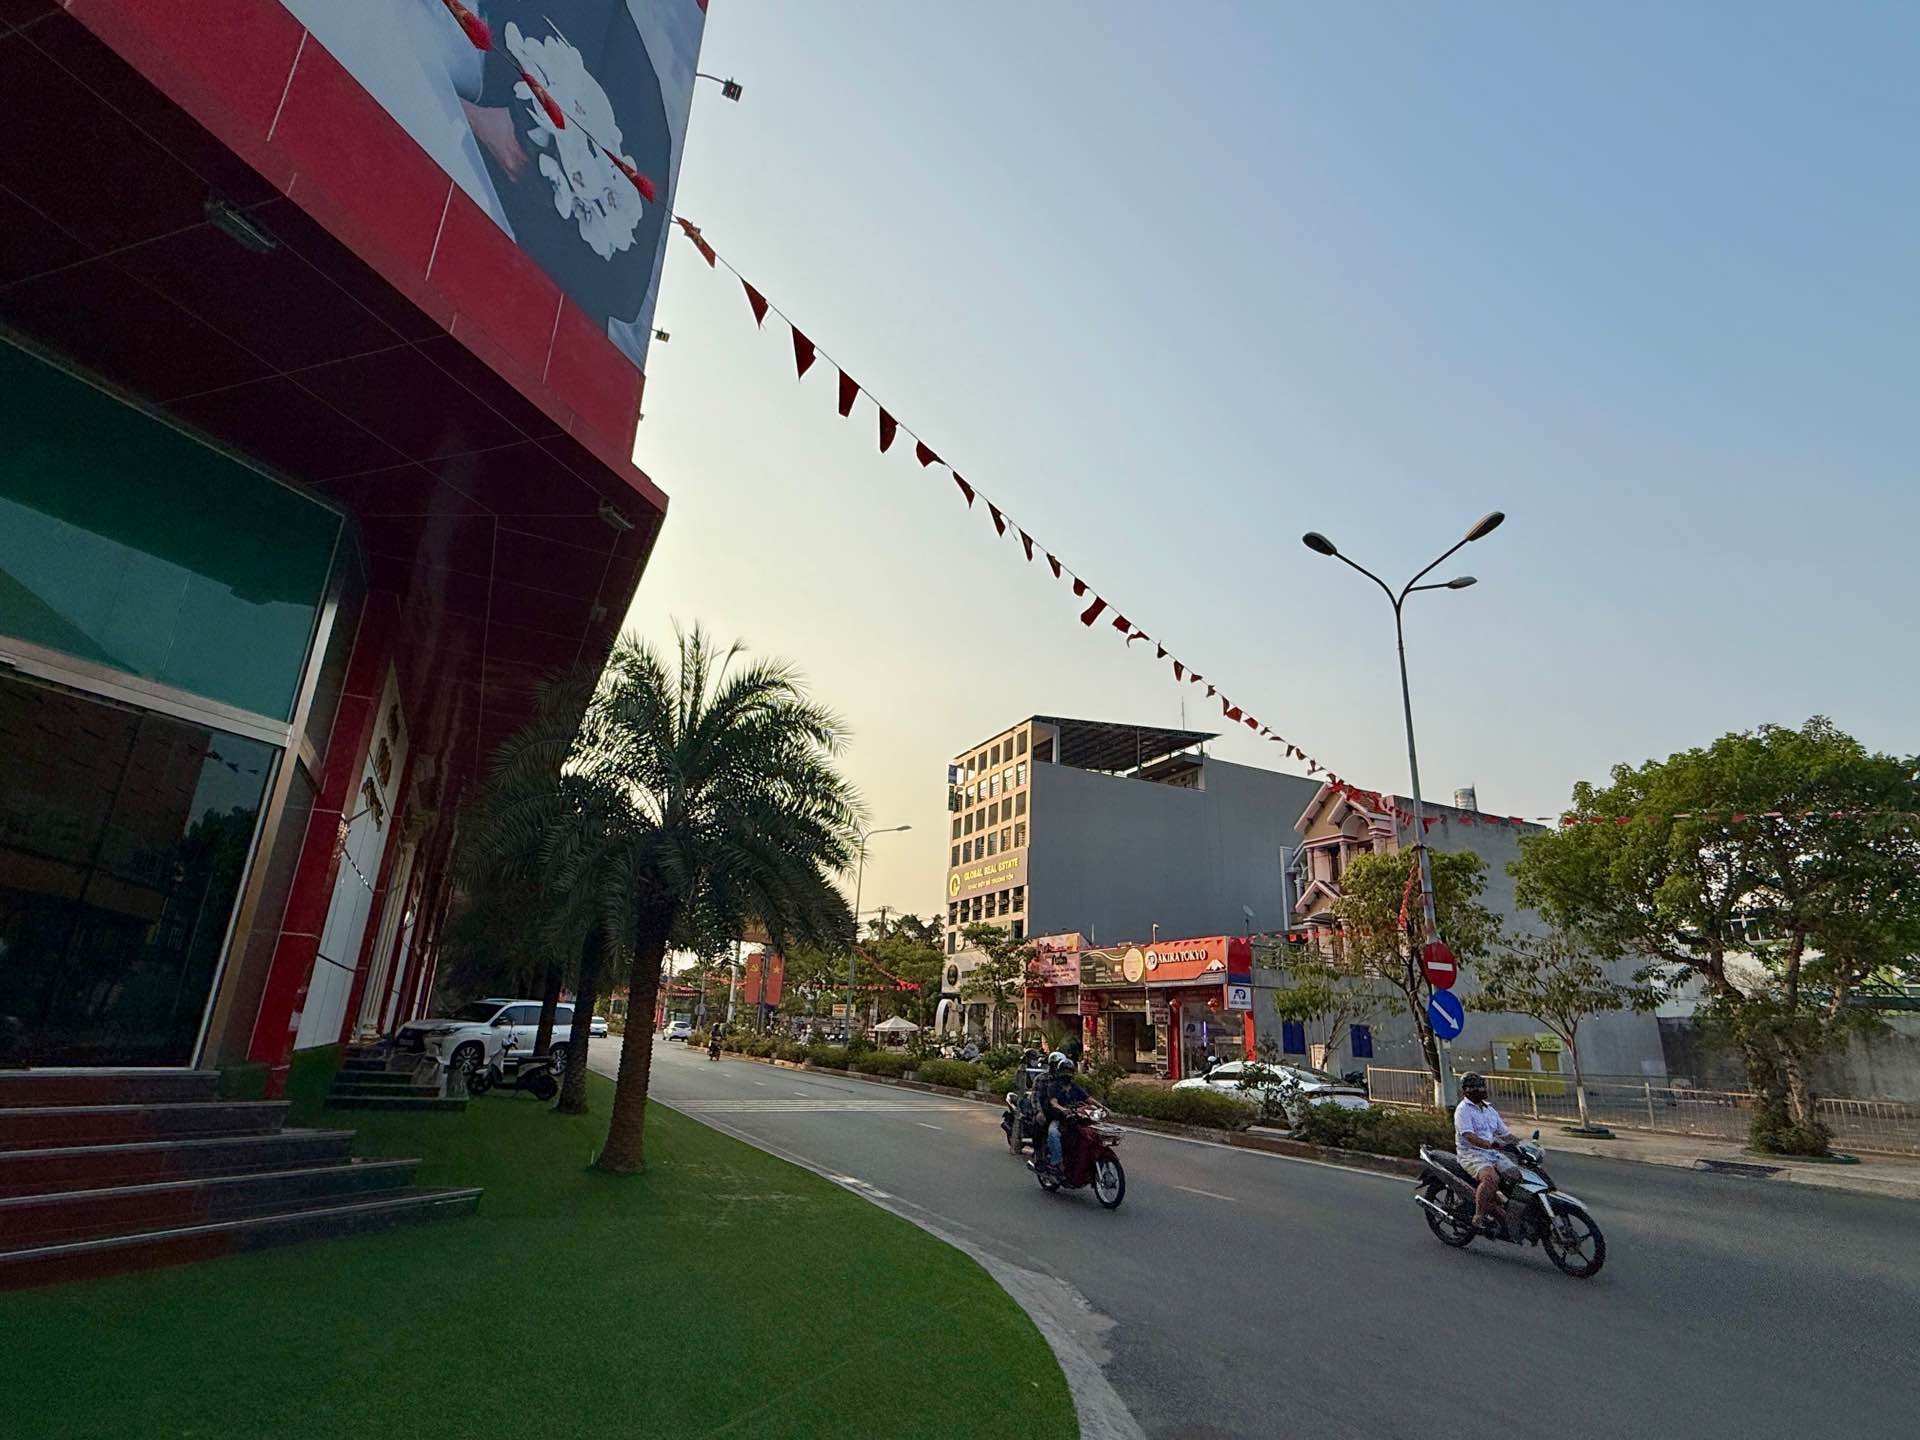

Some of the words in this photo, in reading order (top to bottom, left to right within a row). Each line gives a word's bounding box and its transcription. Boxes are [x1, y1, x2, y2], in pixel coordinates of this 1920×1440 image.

[964, 869, 982, 881] GLOBAL
[984, 863, 997, 876] REAL
[999, 857, 1018, 872] ESTATE
[1158, 951, 1180, 963] AKIRA
[1179, 949, 1206, 962] TOKYO
